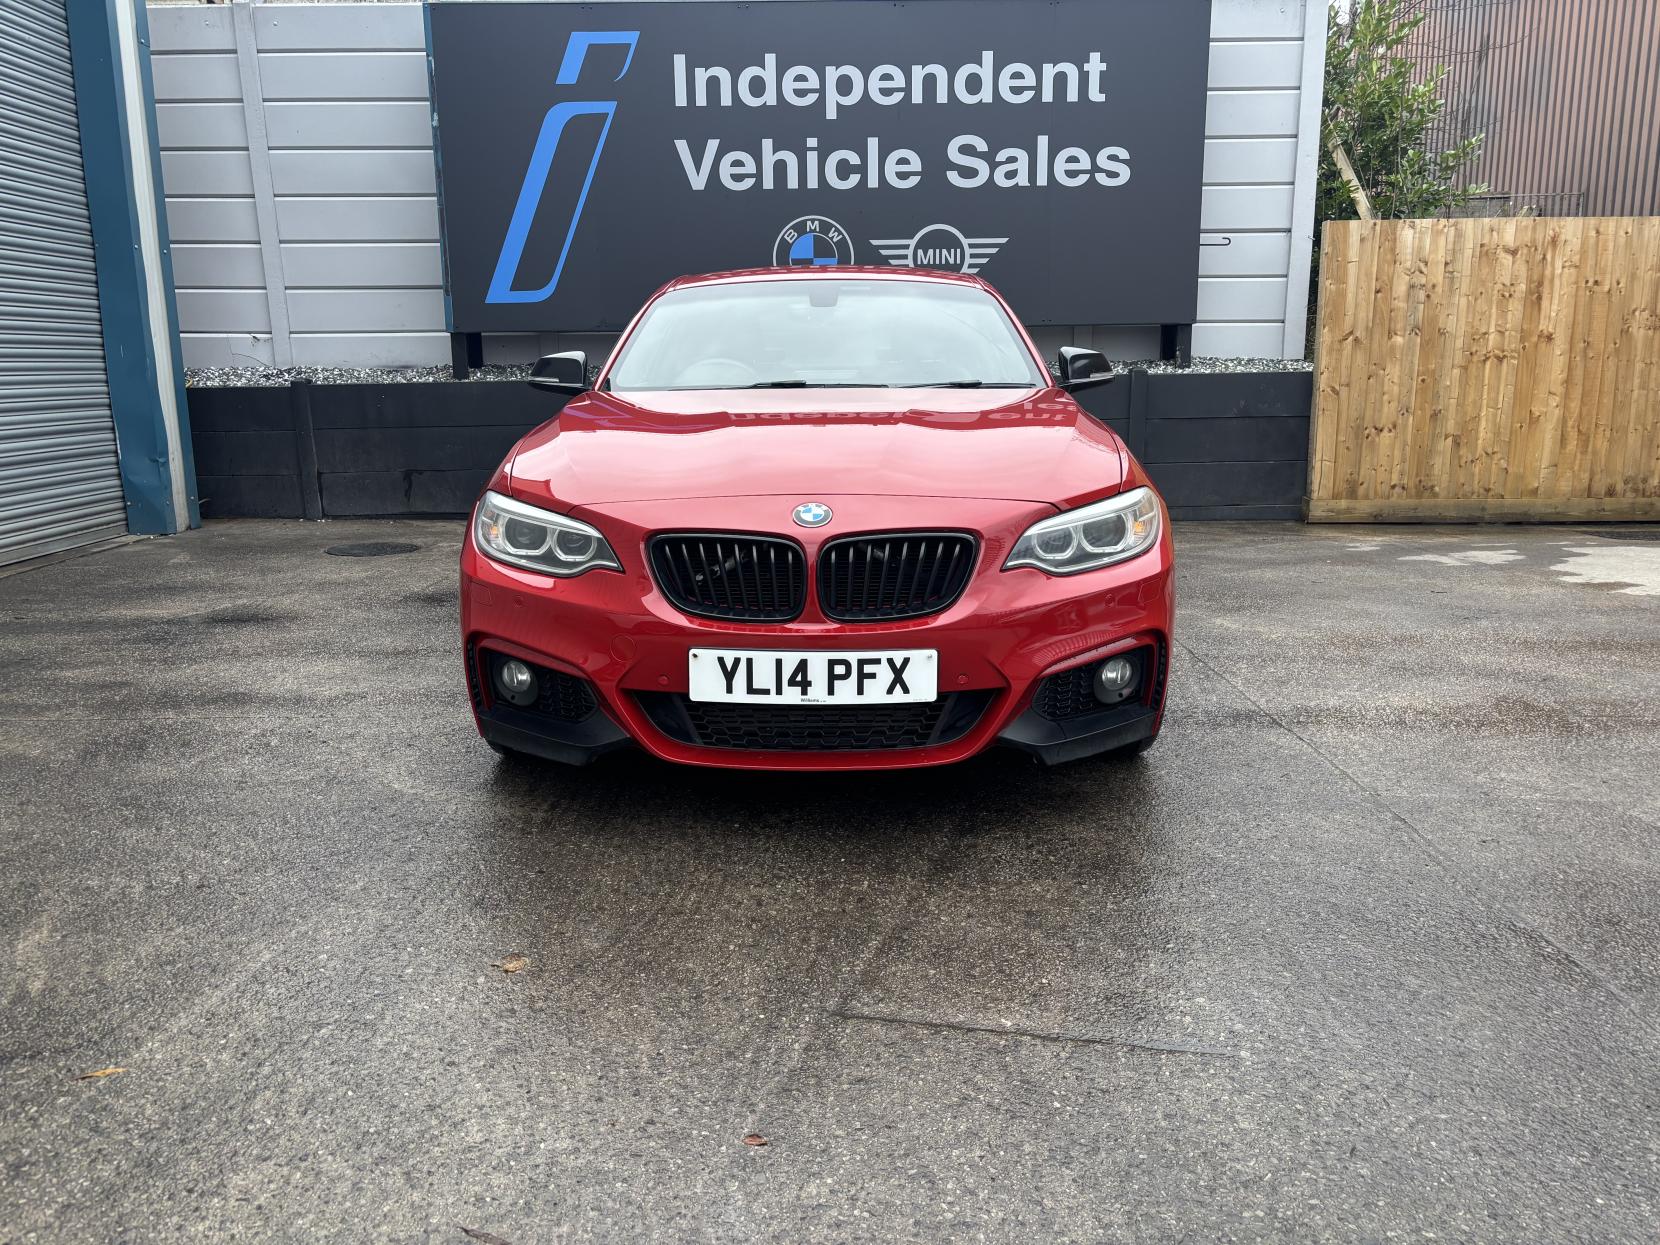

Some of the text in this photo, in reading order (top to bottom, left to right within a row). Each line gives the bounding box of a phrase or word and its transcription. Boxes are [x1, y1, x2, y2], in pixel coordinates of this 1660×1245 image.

[673, 51, 1107, 119] Independent
[673, 135, 1132, 191] Vehicle Sales
[784, 220, 843, 244] BMW
[917, 248, 961, 265] MINI
[717, 656, 911, 696] YL14 PFX
